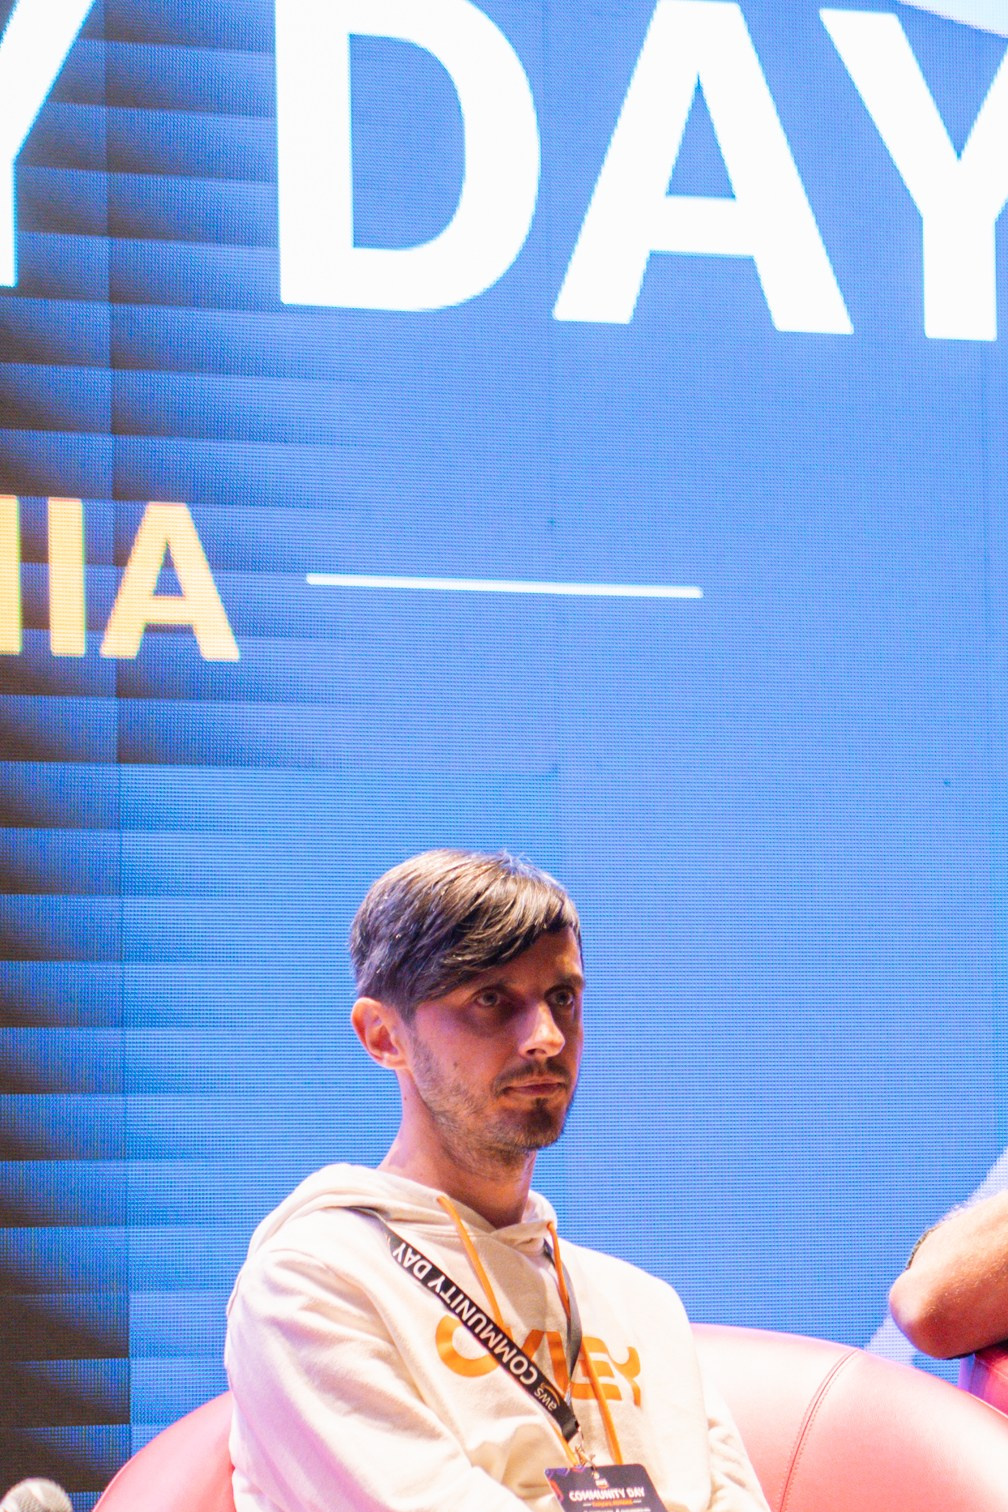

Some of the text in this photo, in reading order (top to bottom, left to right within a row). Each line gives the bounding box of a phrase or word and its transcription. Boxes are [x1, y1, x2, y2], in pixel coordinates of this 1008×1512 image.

[392, 1243, 559, 1411] aws COMMUNITY DAY
[569, 1486, 645, 1502] COMMUNITY DAY
